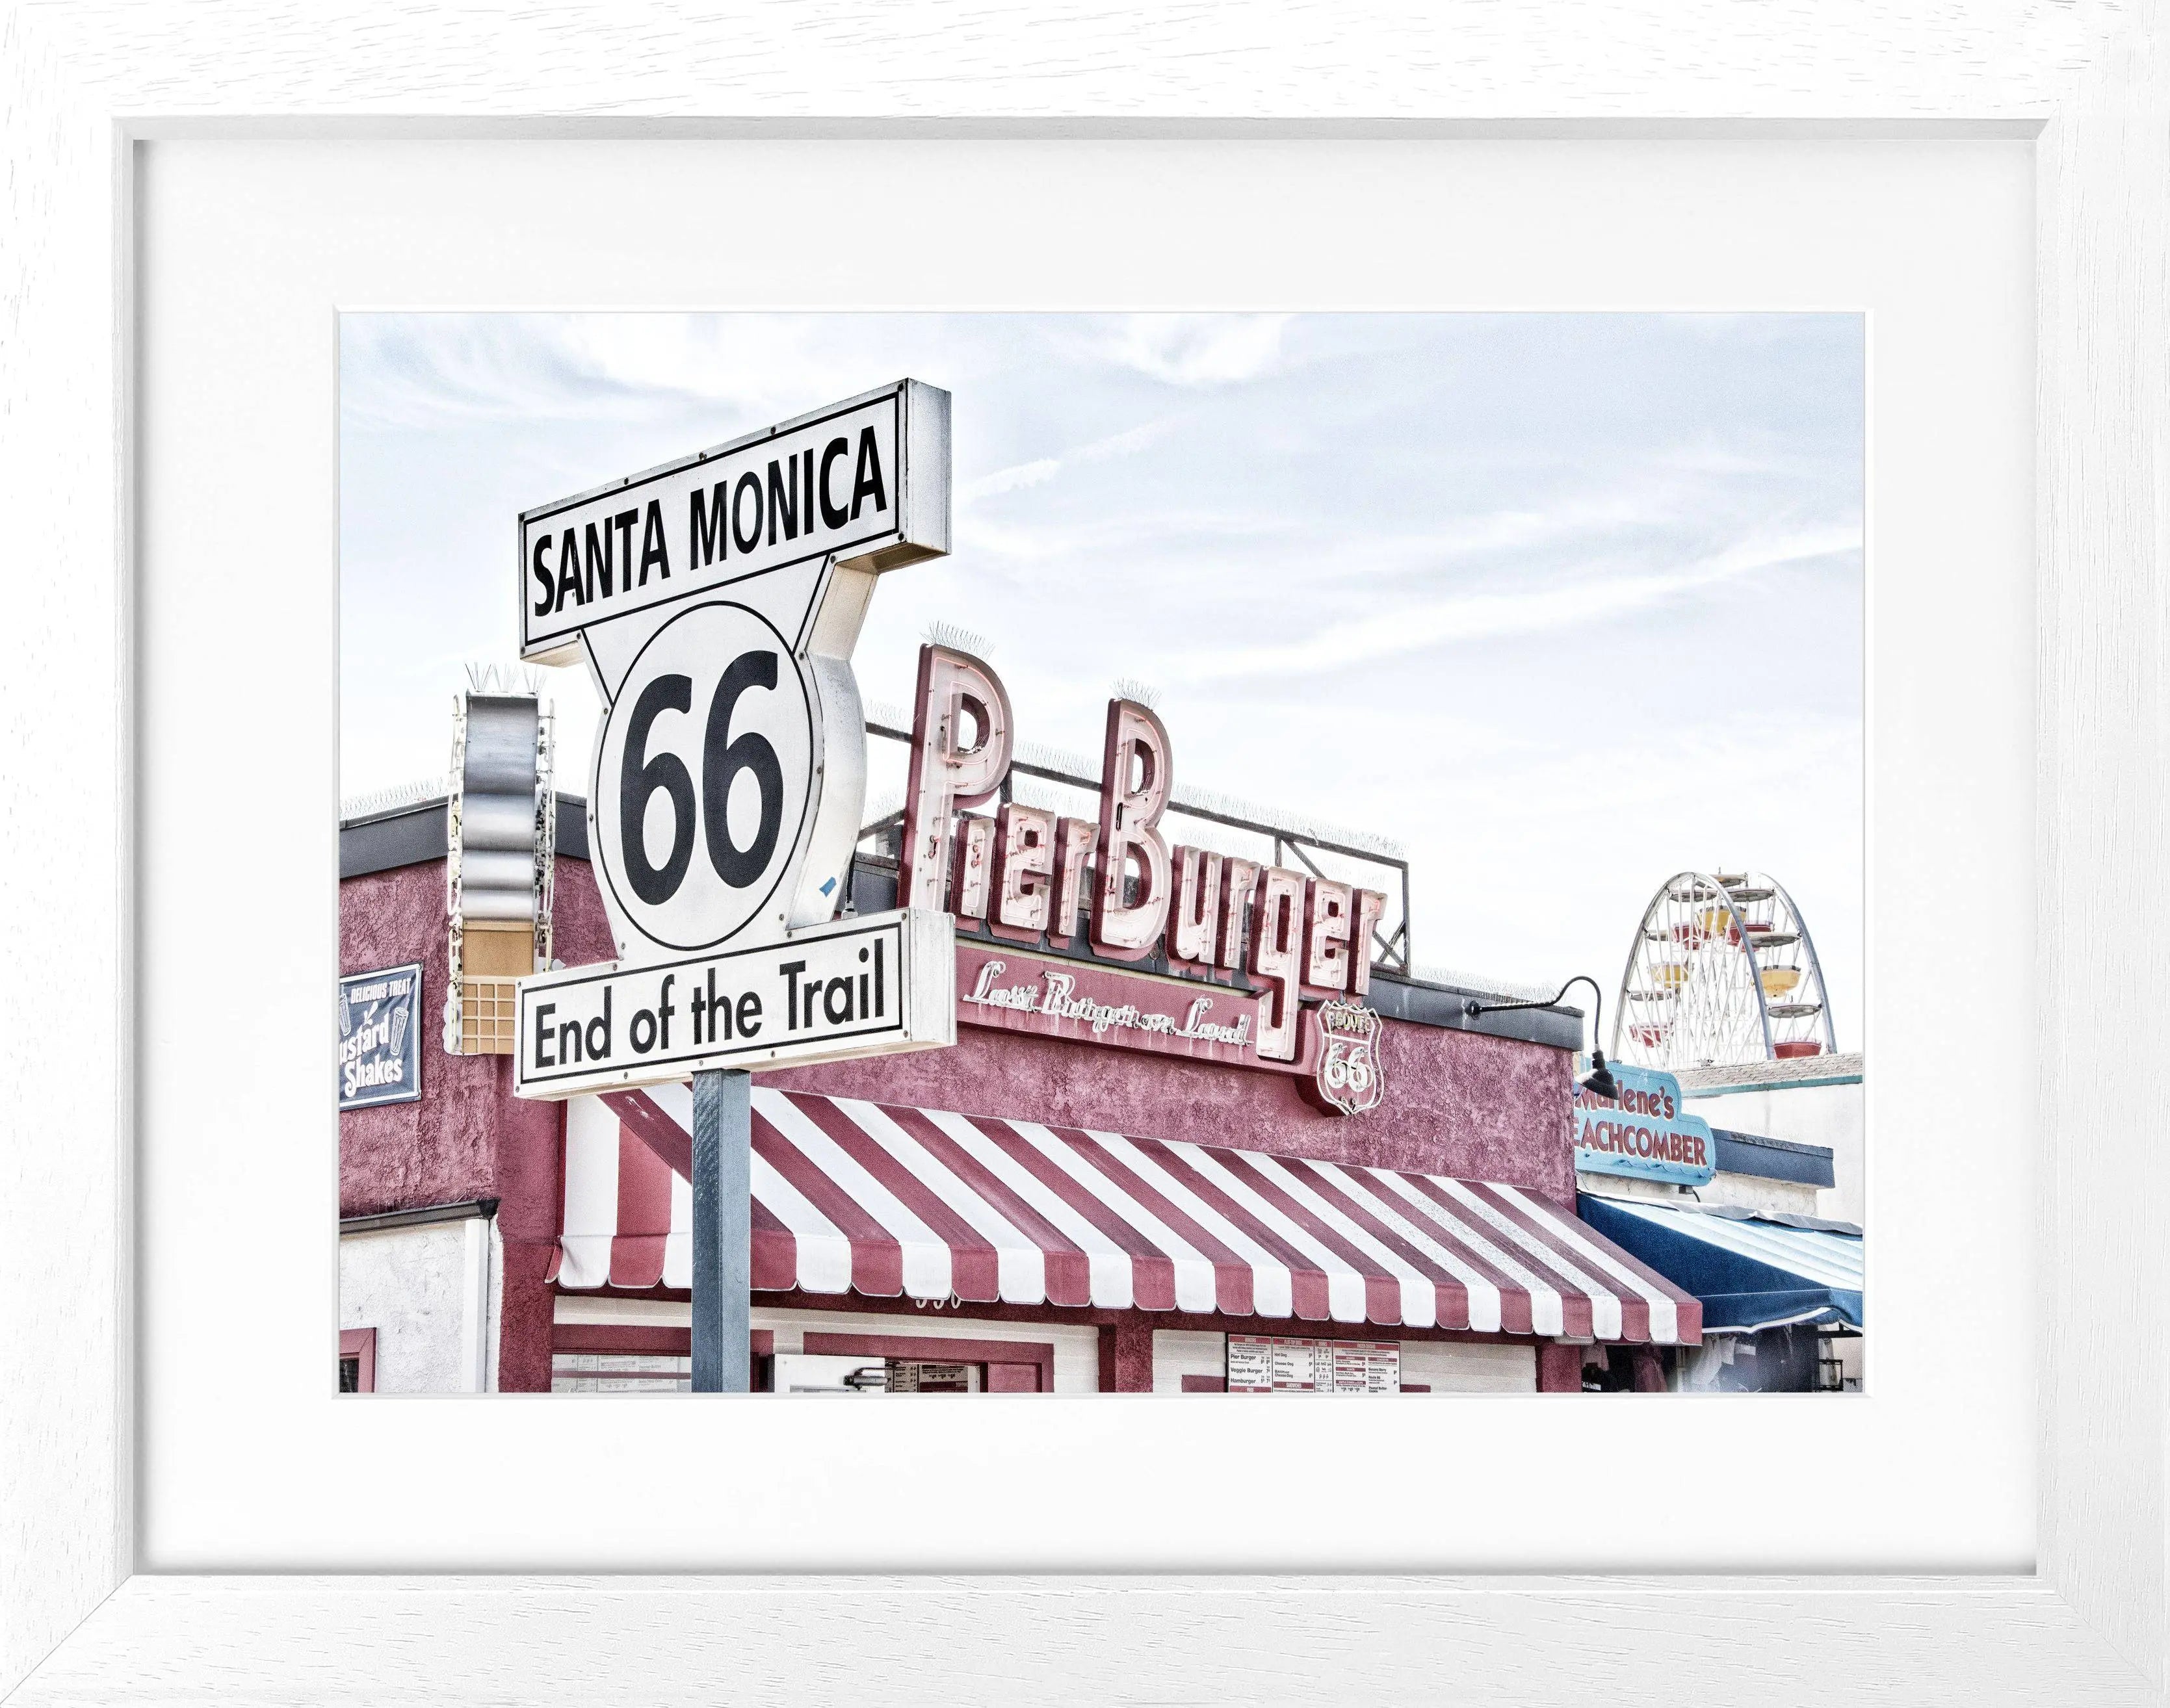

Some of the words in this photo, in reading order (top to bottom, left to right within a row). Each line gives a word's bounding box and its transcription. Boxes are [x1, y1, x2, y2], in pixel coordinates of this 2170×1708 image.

[533, 498, 671, 617] SANTA
[690, 425, 887, 570] MONICA
[620, 650, 783, 905] 66
[1090, 699, 1387, 1061] Burger
[350, 982, 387, 1004] DELICIOUS
[389, 977, 412, 997] TREAT
[535, 986, 612, 1068] End
[630, 974, 675, 1054] of
[692, 968, 763, 1044] the
[780, 938, 883, 1030] Trail
[345, 1053, 402, 1097] Shakes
[1326, 1042, 1374, 1093] 66
